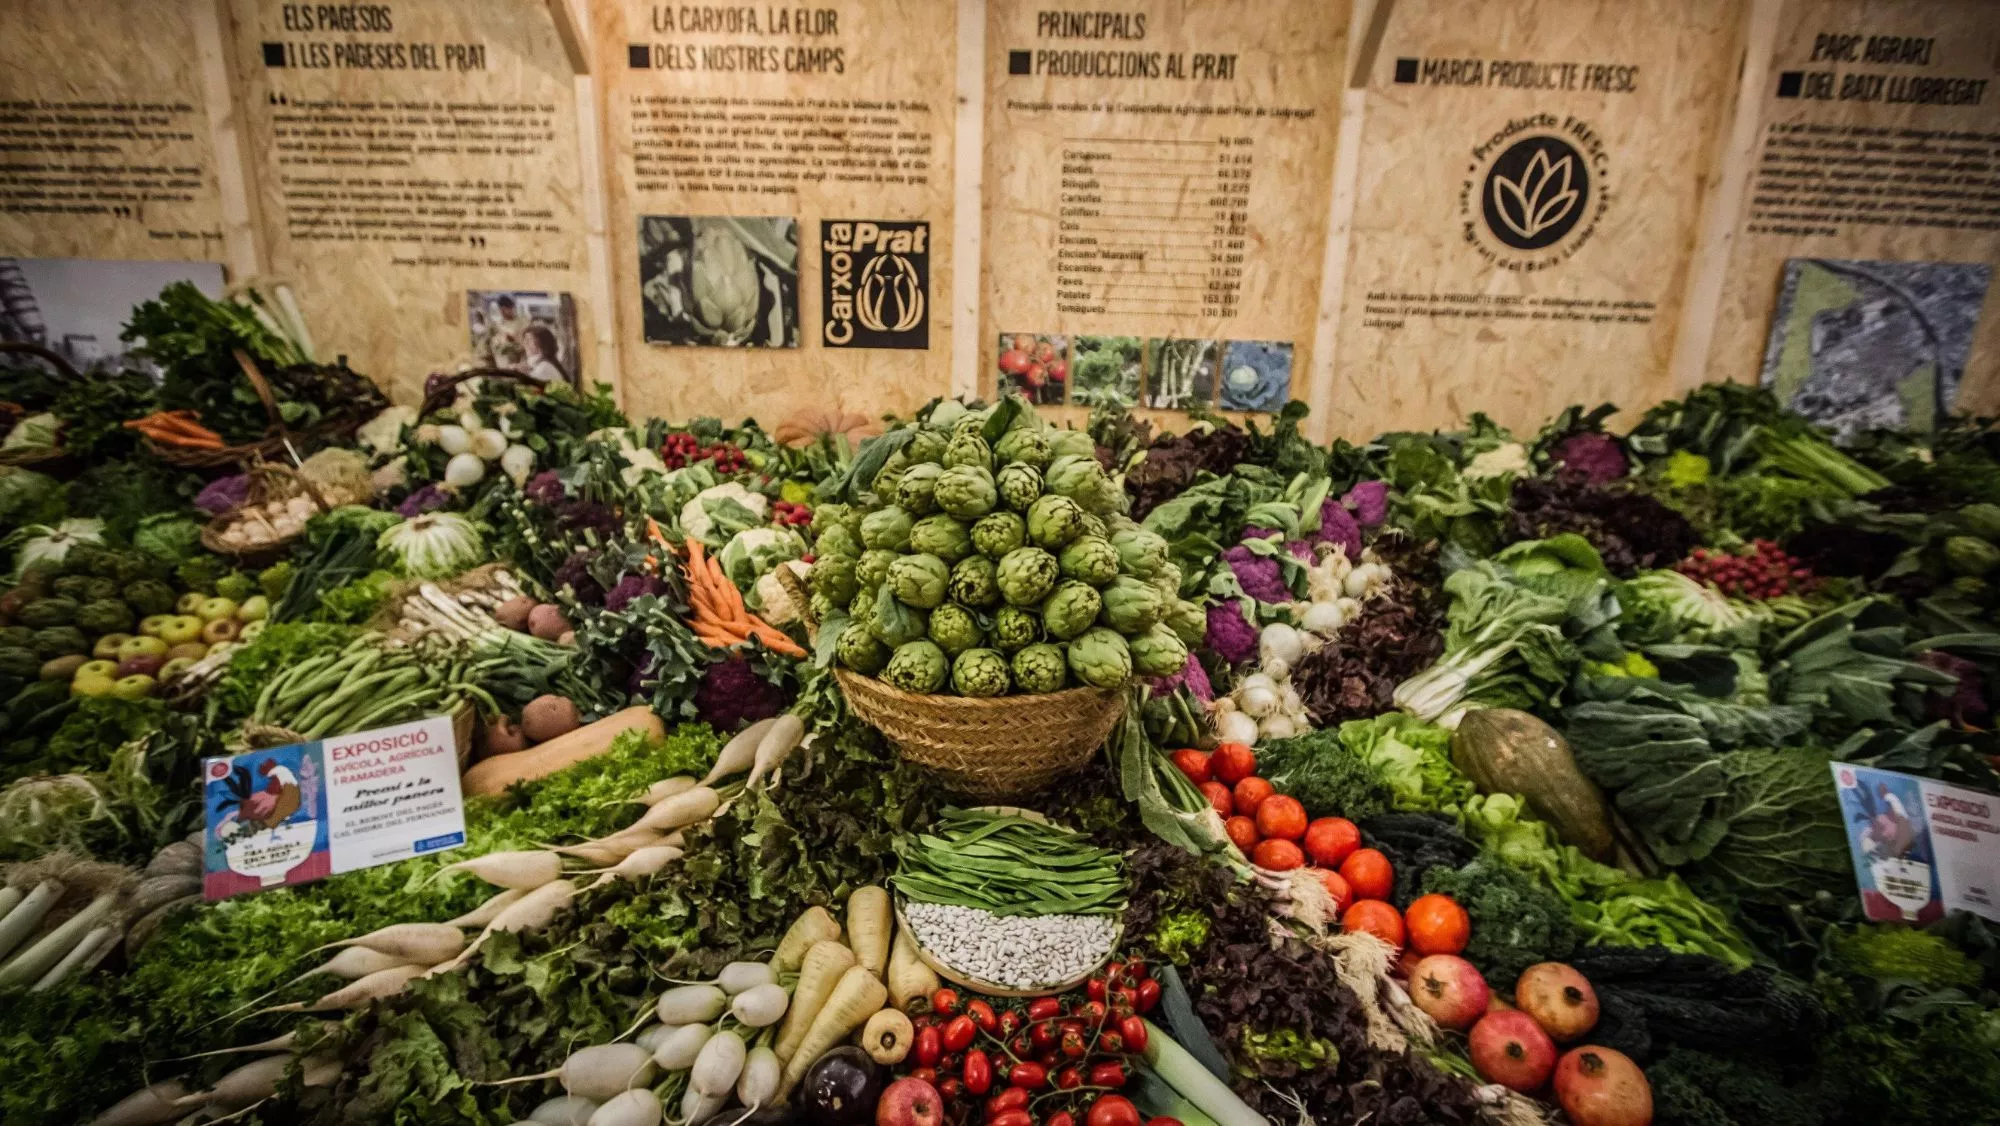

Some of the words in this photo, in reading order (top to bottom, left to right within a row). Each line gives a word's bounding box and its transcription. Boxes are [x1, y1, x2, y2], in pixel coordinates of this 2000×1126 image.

[283, 4, 314, 32] ELS
[316, 4, 393, 33] PAGESOS
[652, 5, 675, 33] LA
[768, 6, 790, 35] LA
[795, 8, 839, 36] FLOR
[1037, 11, 1147, 40] PRINCIPALS
[302, 43, 331, 69] LES
[333, 43, 407, 71] PAGESES
[410, 44, 440, 71] DEL
[445, 44, 486, 72] PRAT
[654, 44, 697, 71] DELS
[702, 45, 780, 73] NOSTRES
[784, 46, 845, 74] CAMPS
[1809, 32, 1863, 64] PARC
[1862, 35, 1936, 66] AGRARI
[1036, 50, 1162, 79] PRODUCCIONS
[1166, 53, 1186, 79] AL
[1192, 53, 1239, 81] PRAT
[1420, 57, 1484, 88] MARCA
[1486, 59, 1579, 92] PRODUCTE
[1581, 63, 1641, 94] FRESC
[1803, 70, 1836, 99] DEL
[1839, 73, 1888, 101] BAIX
[1884, 75, 1990, 106] LLOBREGAT
[1472, 113, 1558, 161] Producte
[1562, 115, 1609, 165] FRESC
[824, 223, 853, 345] Carxofa
[852, 222, 927, 254] Prat
[332, 728, 428, 761] EXPOSICIÓ
[388, 745, 444, 763] AGRÍCOLA
[340, 765, 406, 784] RAMADERA
[355, 782, 402, 799] Premi
[418, 777, 431, 786] la
[343, 798, 389, 813] millor
[392, 787, 444, 806] panera
